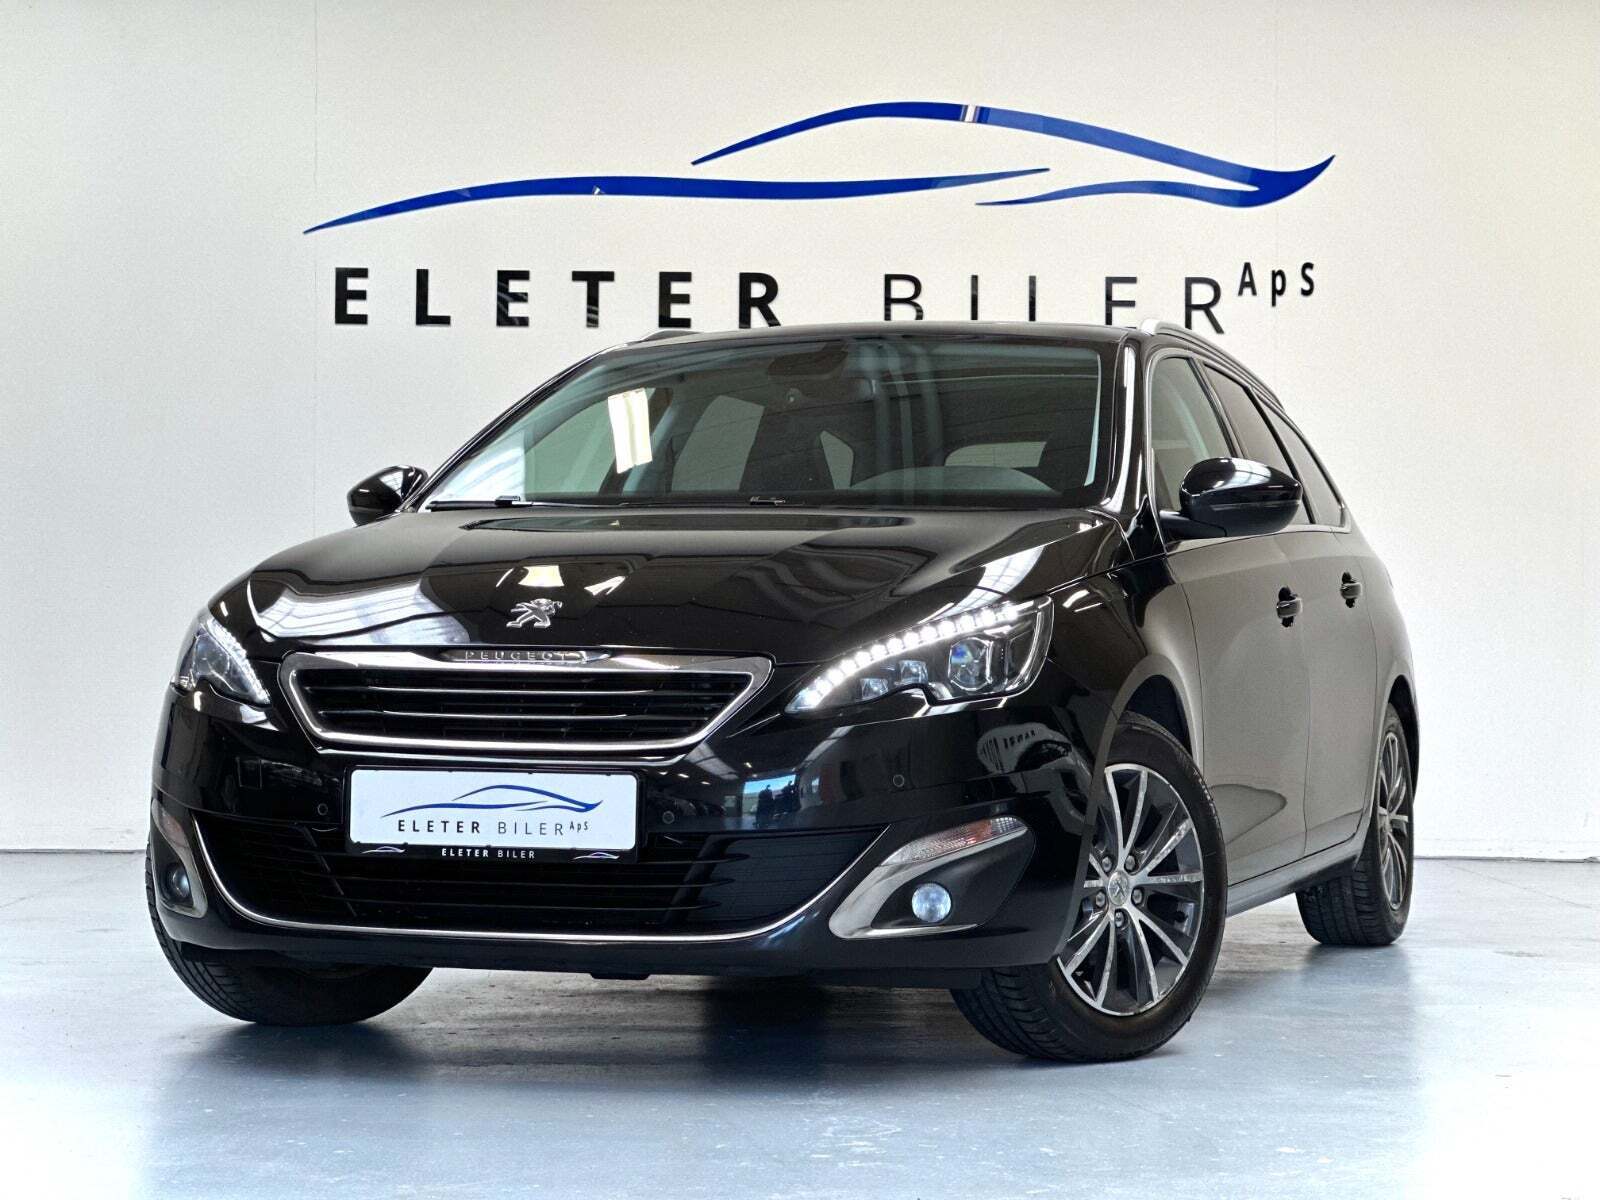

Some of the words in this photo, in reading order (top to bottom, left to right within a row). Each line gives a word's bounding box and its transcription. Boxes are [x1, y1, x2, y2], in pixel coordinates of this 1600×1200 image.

[335, 267, 782, 329] ELETER
[1237, 262, 1315, 306] ApS
[465, 650, 569, 661] PEUGEOT
[398, 819, 481, 835] ELETER
[498, 821, 563, 836] BILER
[569, 821, 589, 833] ApS
[441, 848, 489, 858] ELETER
[497, 849, 535, 859] BILER
